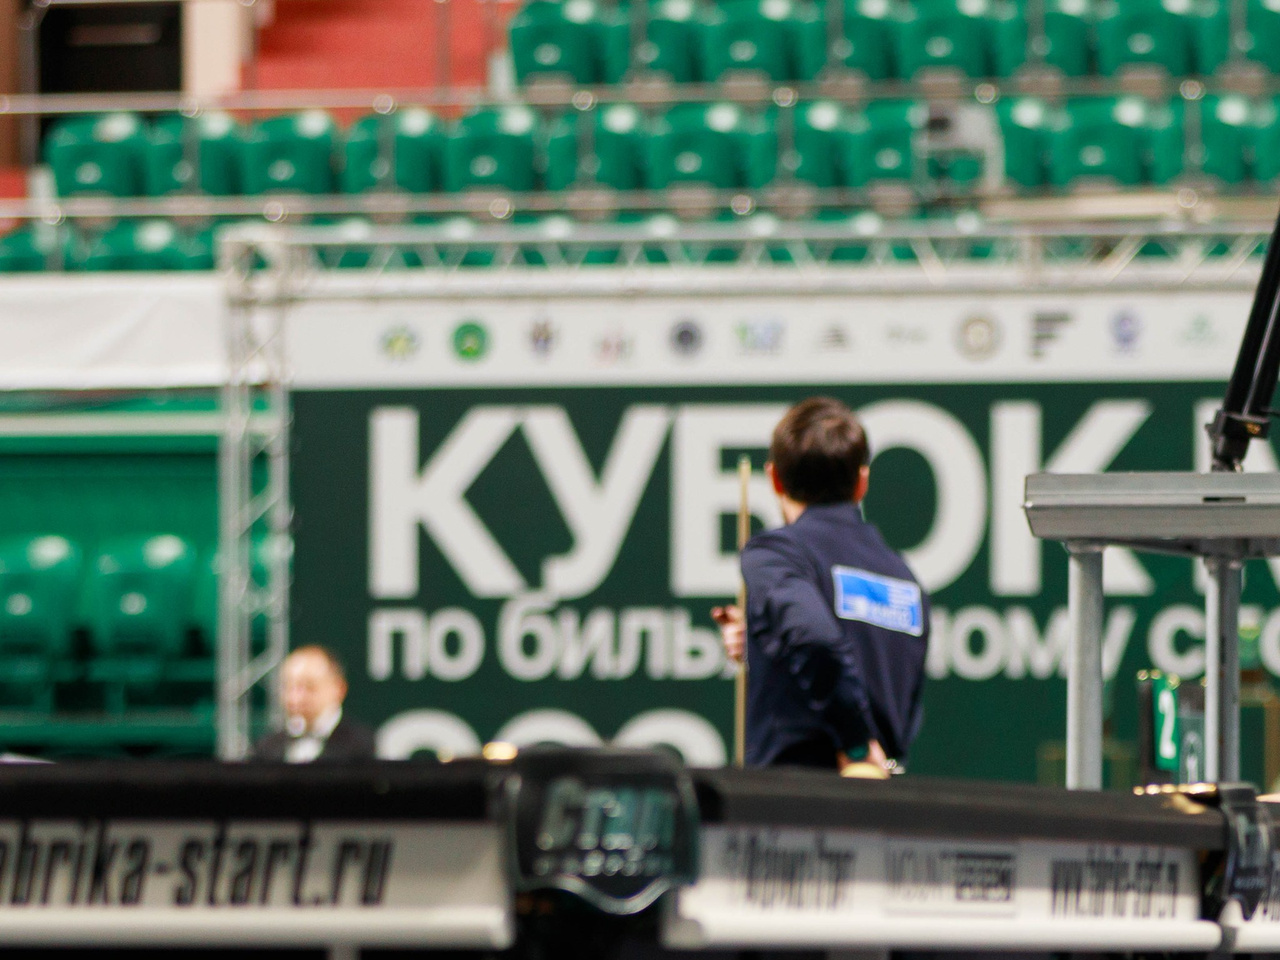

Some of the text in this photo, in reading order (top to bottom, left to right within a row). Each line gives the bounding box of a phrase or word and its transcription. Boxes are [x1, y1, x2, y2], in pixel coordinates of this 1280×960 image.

[368, 400, 1152, 600] КУБОК
[368, 606, 486, 684] по
[498, 592, 1137, 685] бильому
